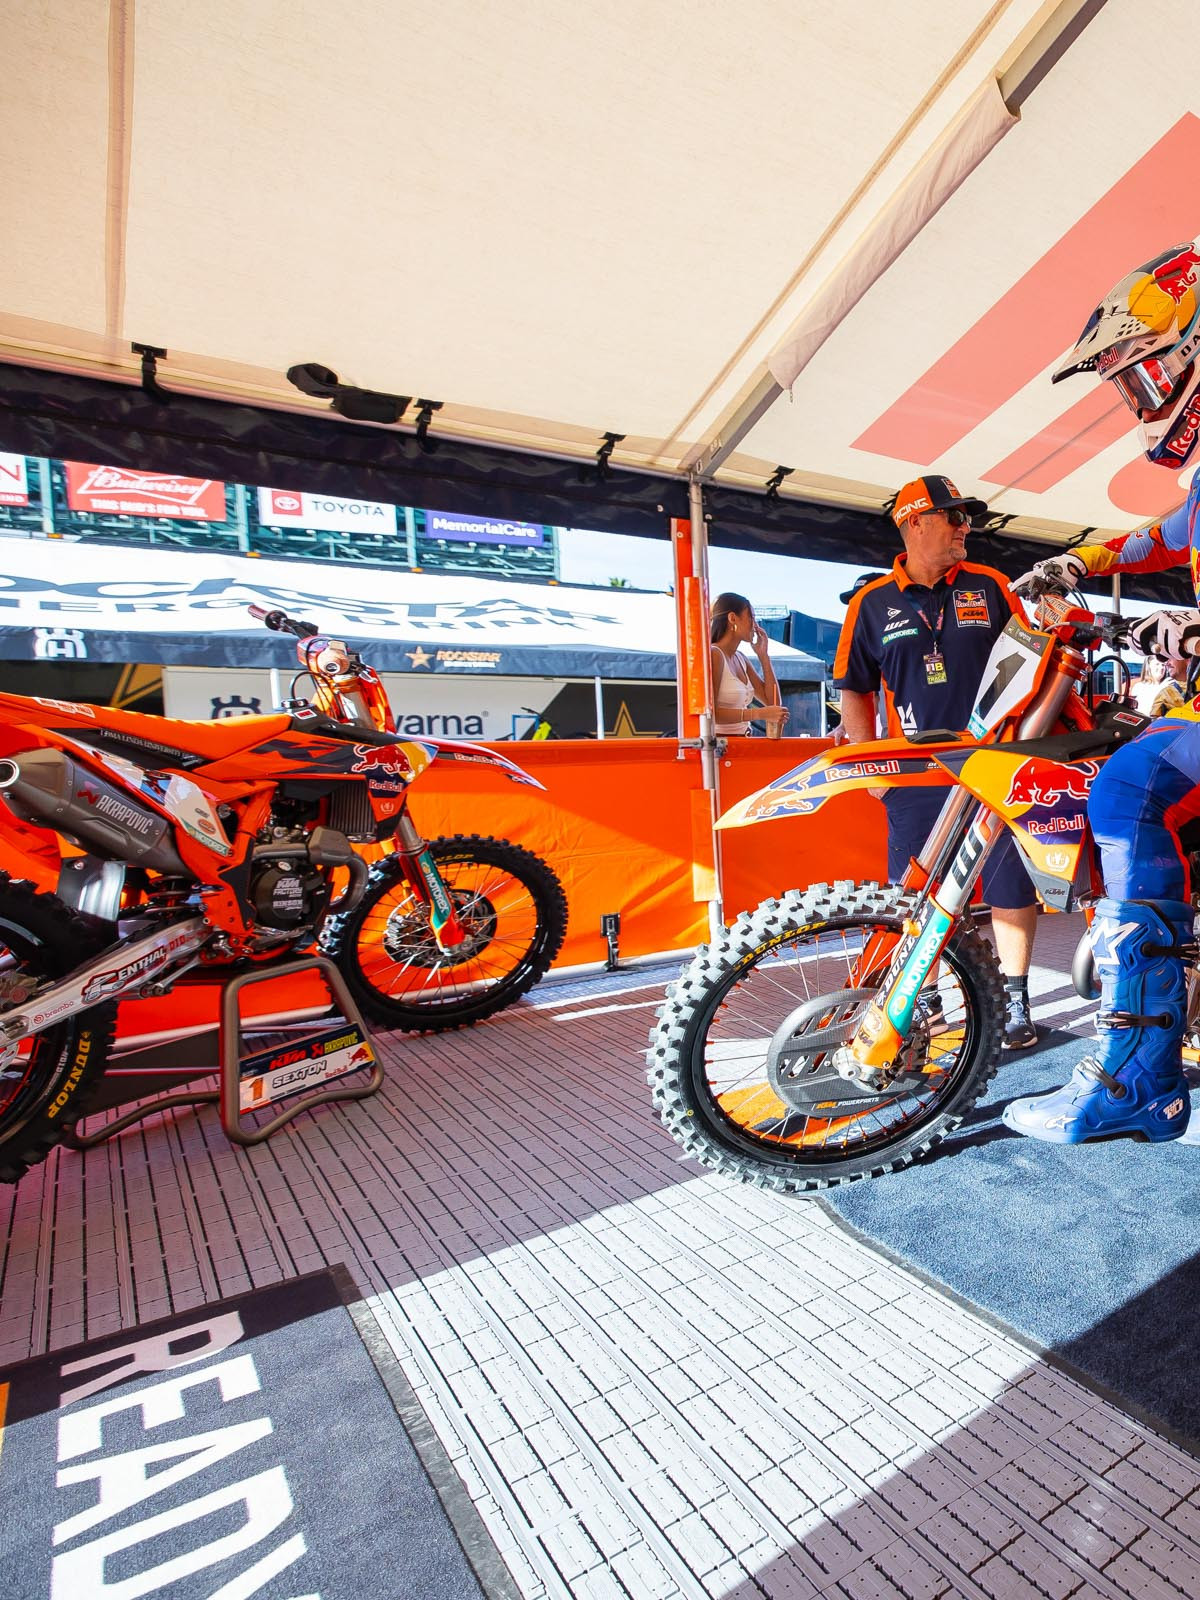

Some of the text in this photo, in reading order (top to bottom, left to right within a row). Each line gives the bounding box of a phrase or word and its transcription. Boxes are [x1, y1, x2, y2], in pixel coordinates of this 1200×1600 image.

[88, 468, 200, 495] Budweiser
[311, 499, 385, 517] TOYOTA
[888, 628, 918, 641] MOTOREX
[436, 650, 502, 662] ROCKSTAR
[824, 759, 901, 783] Red Bull
[1028, 814, 1086, 836] Red Bull
[425, 871, 450, 914] MOTOREX
[741, 920, 828, 965] DUNLOP
[903, 926, 945, 996] MOTOREX
[85, 946, 166, 1001] RENTHAL
[44, 1000, 75, 1019] brembo
[269, 1048, 307, 1071] KTM
[48, 1039, 92, 1119] DUNLOP
[272, 1060, 327, 1089] SEXTON
[249, 1077, 264, 1101] 1
